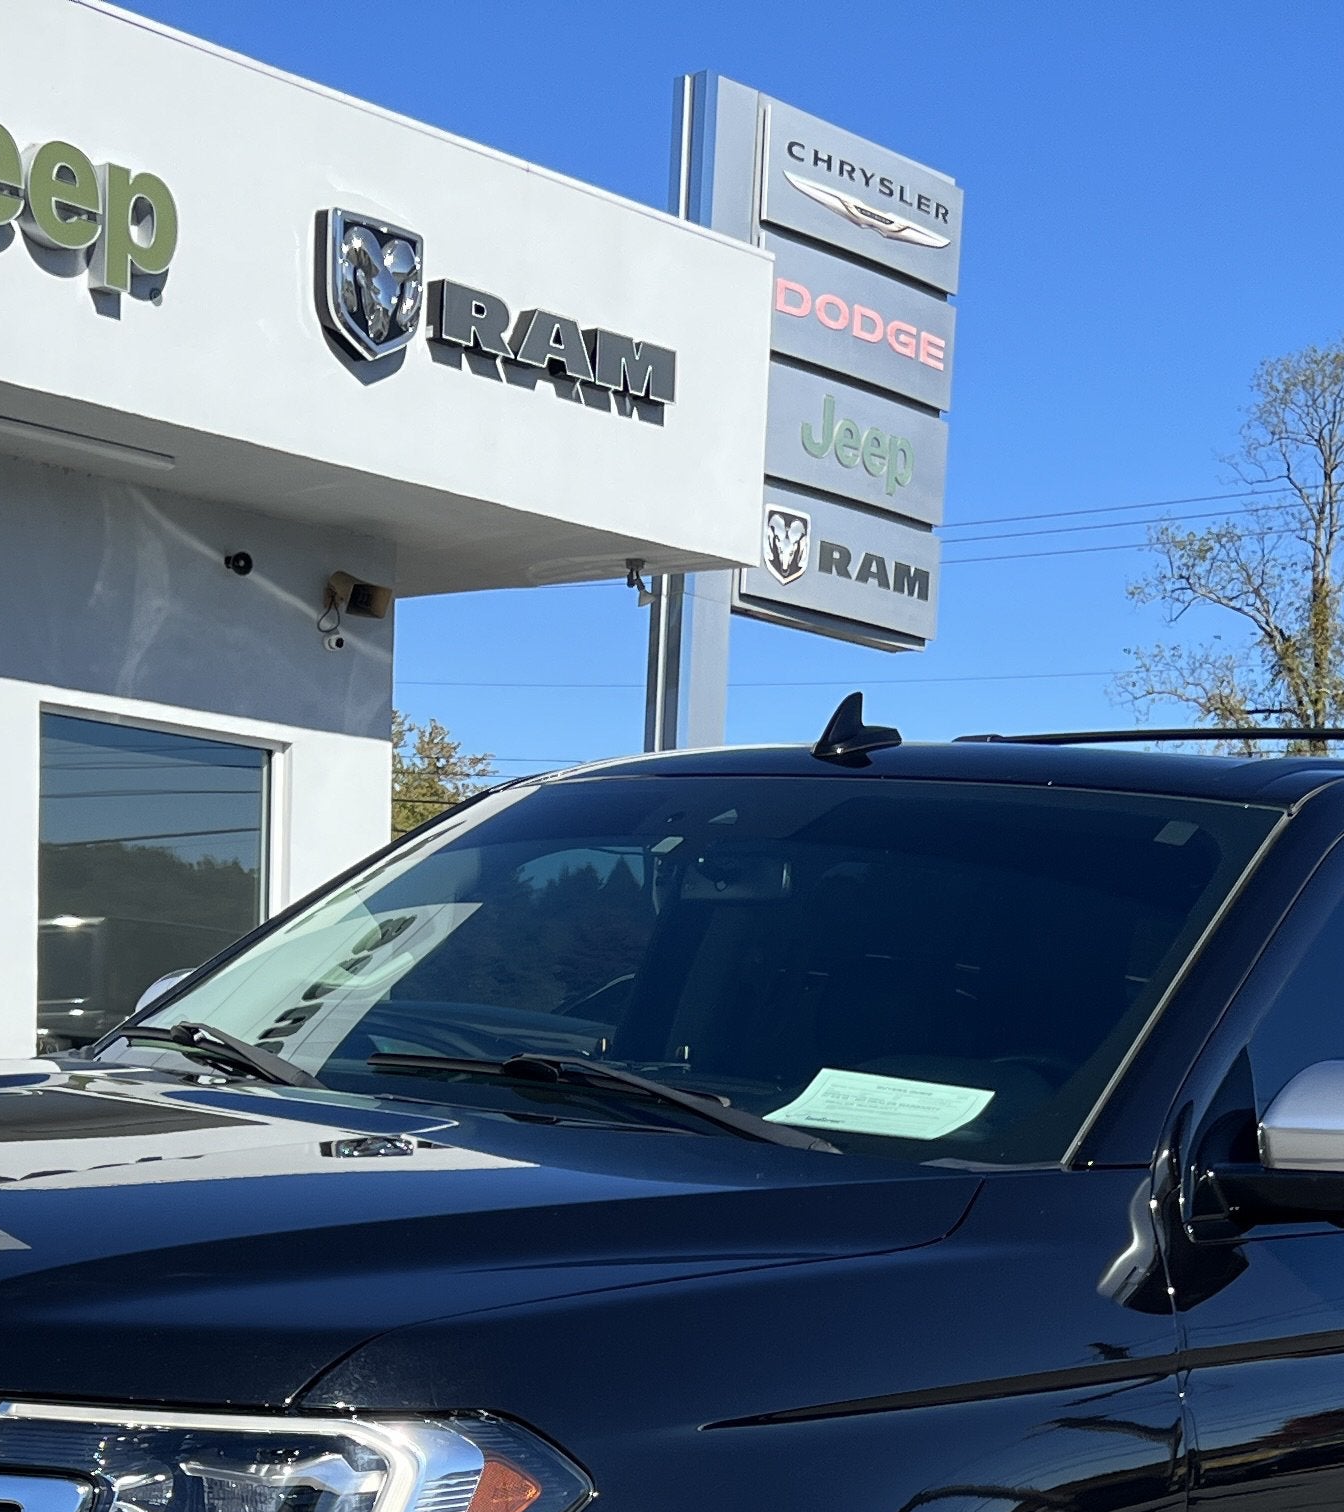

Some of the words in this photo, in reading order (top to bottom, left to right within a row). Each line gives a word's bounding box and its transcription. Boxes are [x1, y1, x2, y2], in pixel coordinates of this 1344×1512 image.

[786, 140, 950, 225] CHRYSLER
[431, 279, 677, 405] RAM
[775, 276, 946, 372] DODGE
[800, 394, 915, 496] Jeep
[818, 540, 930, 602] RAM
